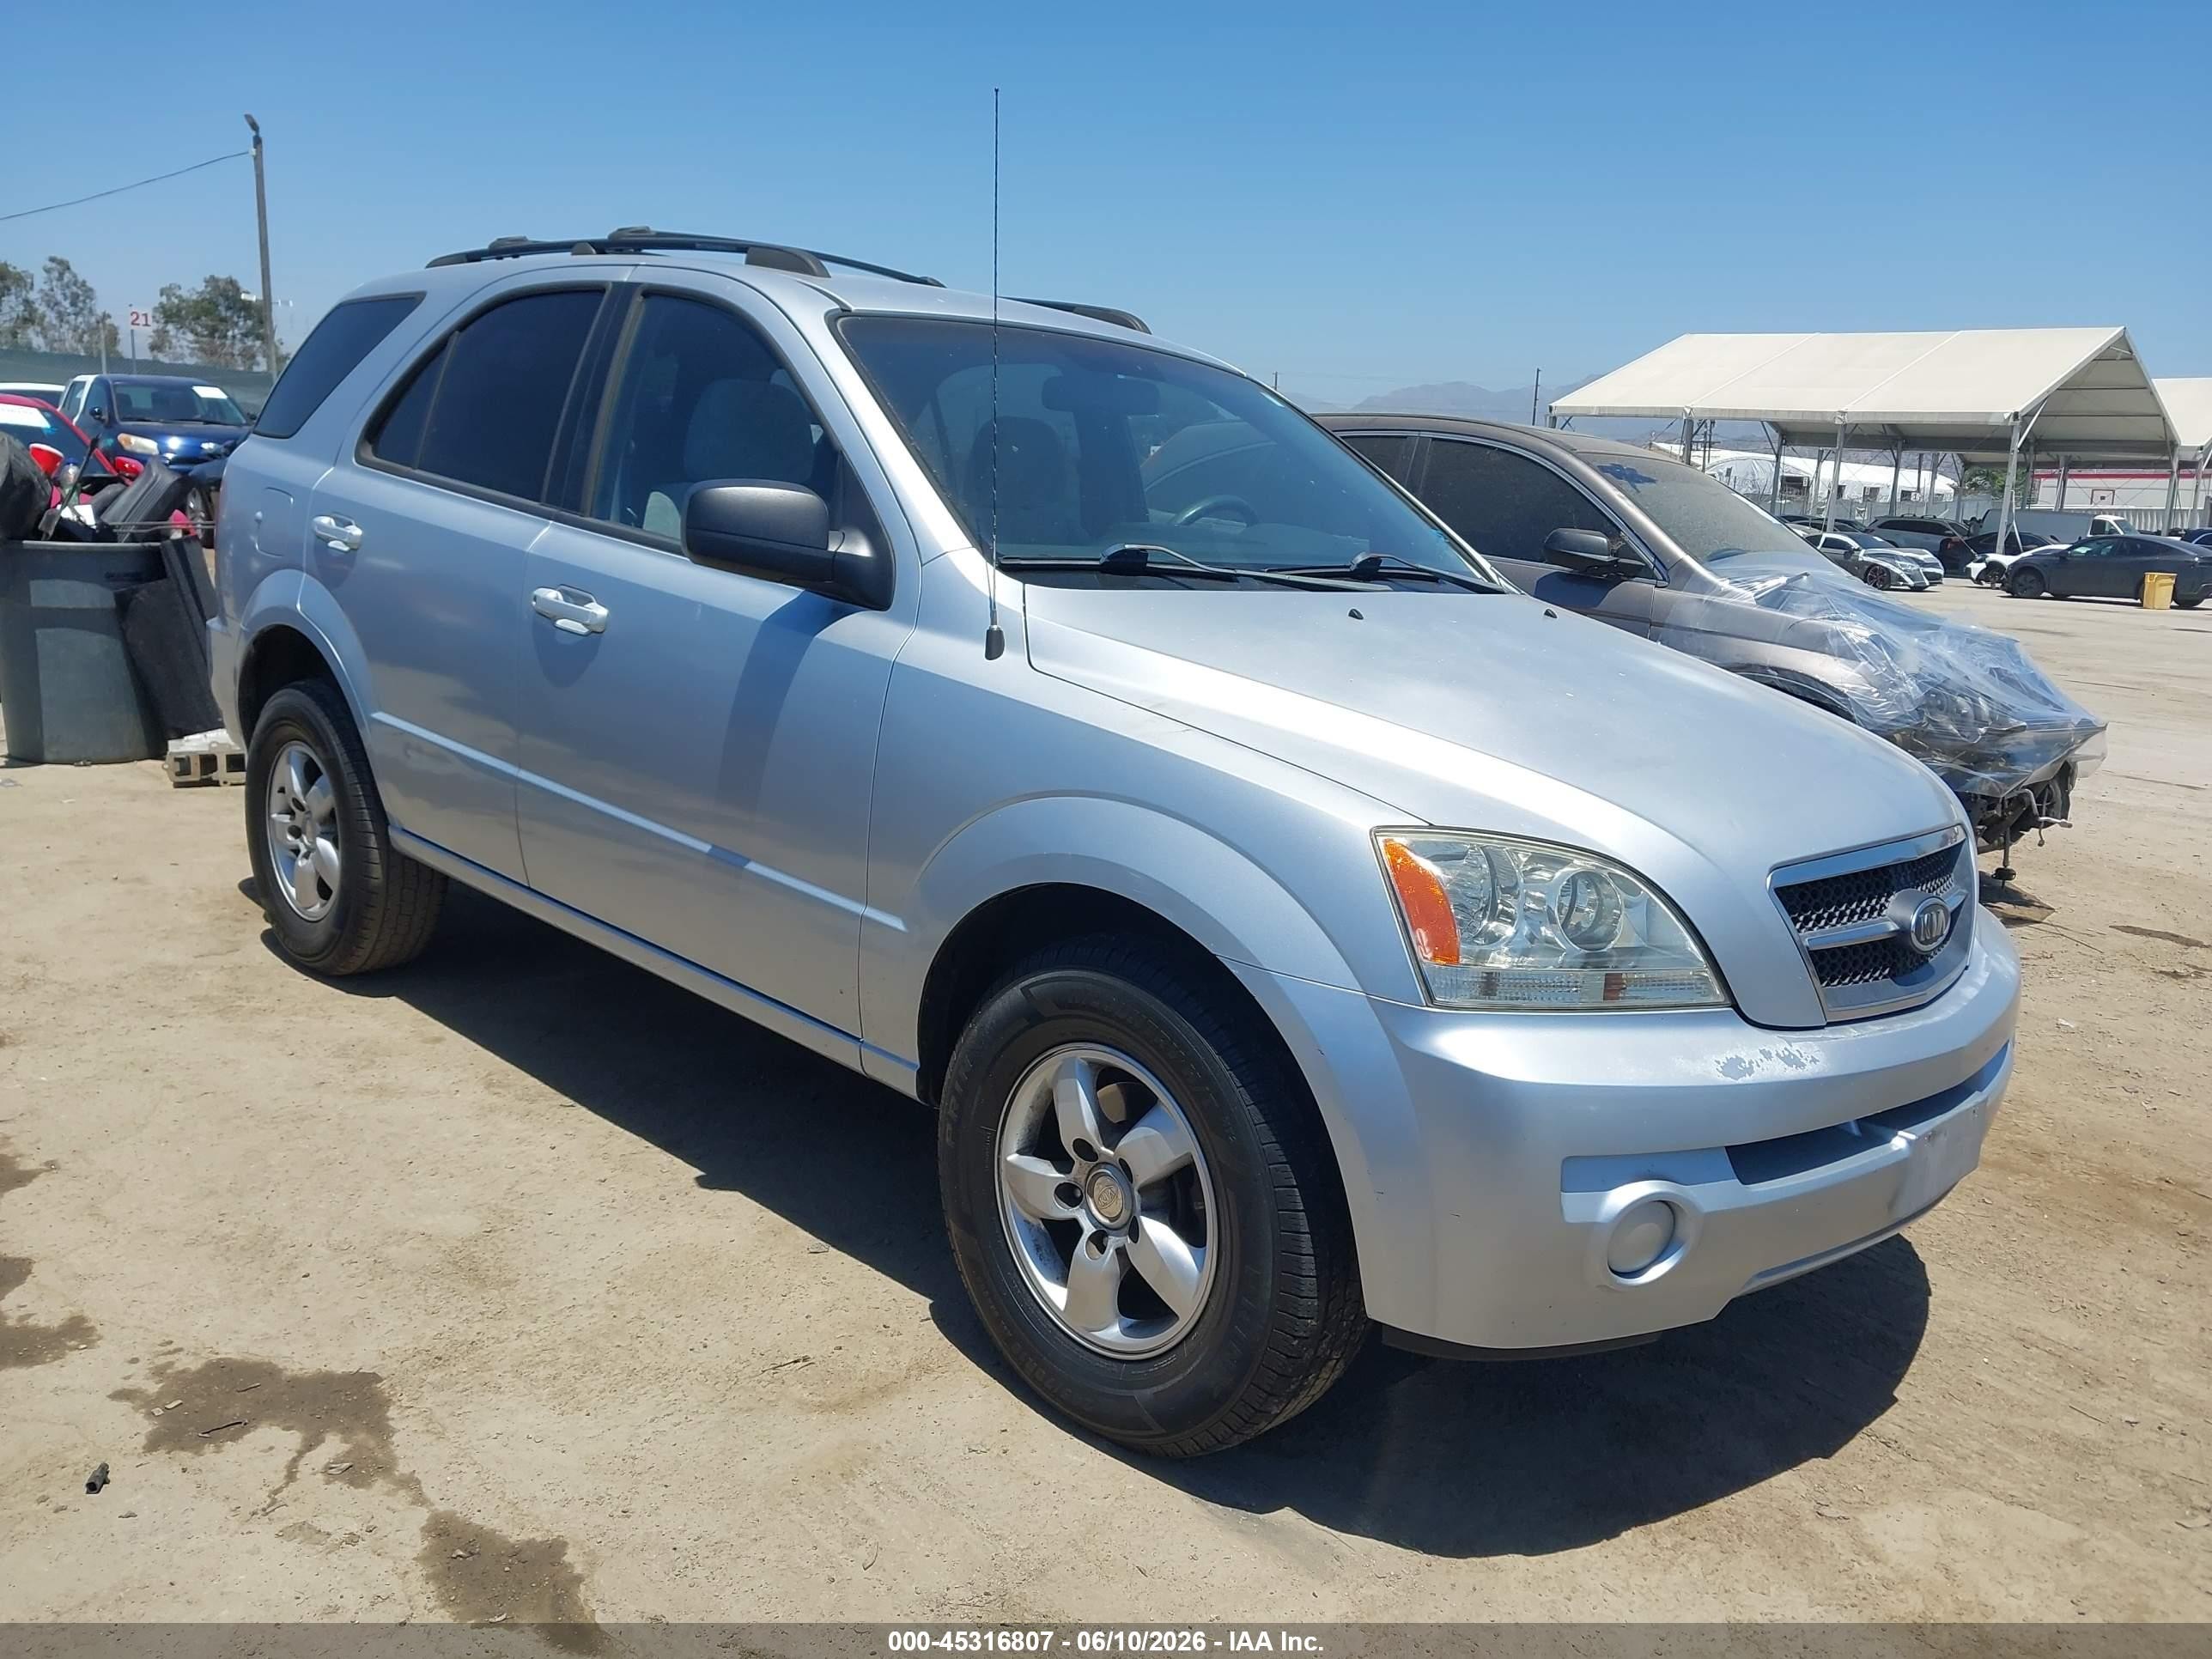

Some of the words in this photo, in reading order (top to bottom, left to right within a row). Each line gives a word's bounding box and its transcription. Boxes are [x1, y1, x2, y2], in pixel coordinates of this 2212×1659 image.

[130, 311, 152, 326] 21
[1919, 908, 1946, 941] KIA
[1099, 1187, 1115, 1206] KIA
